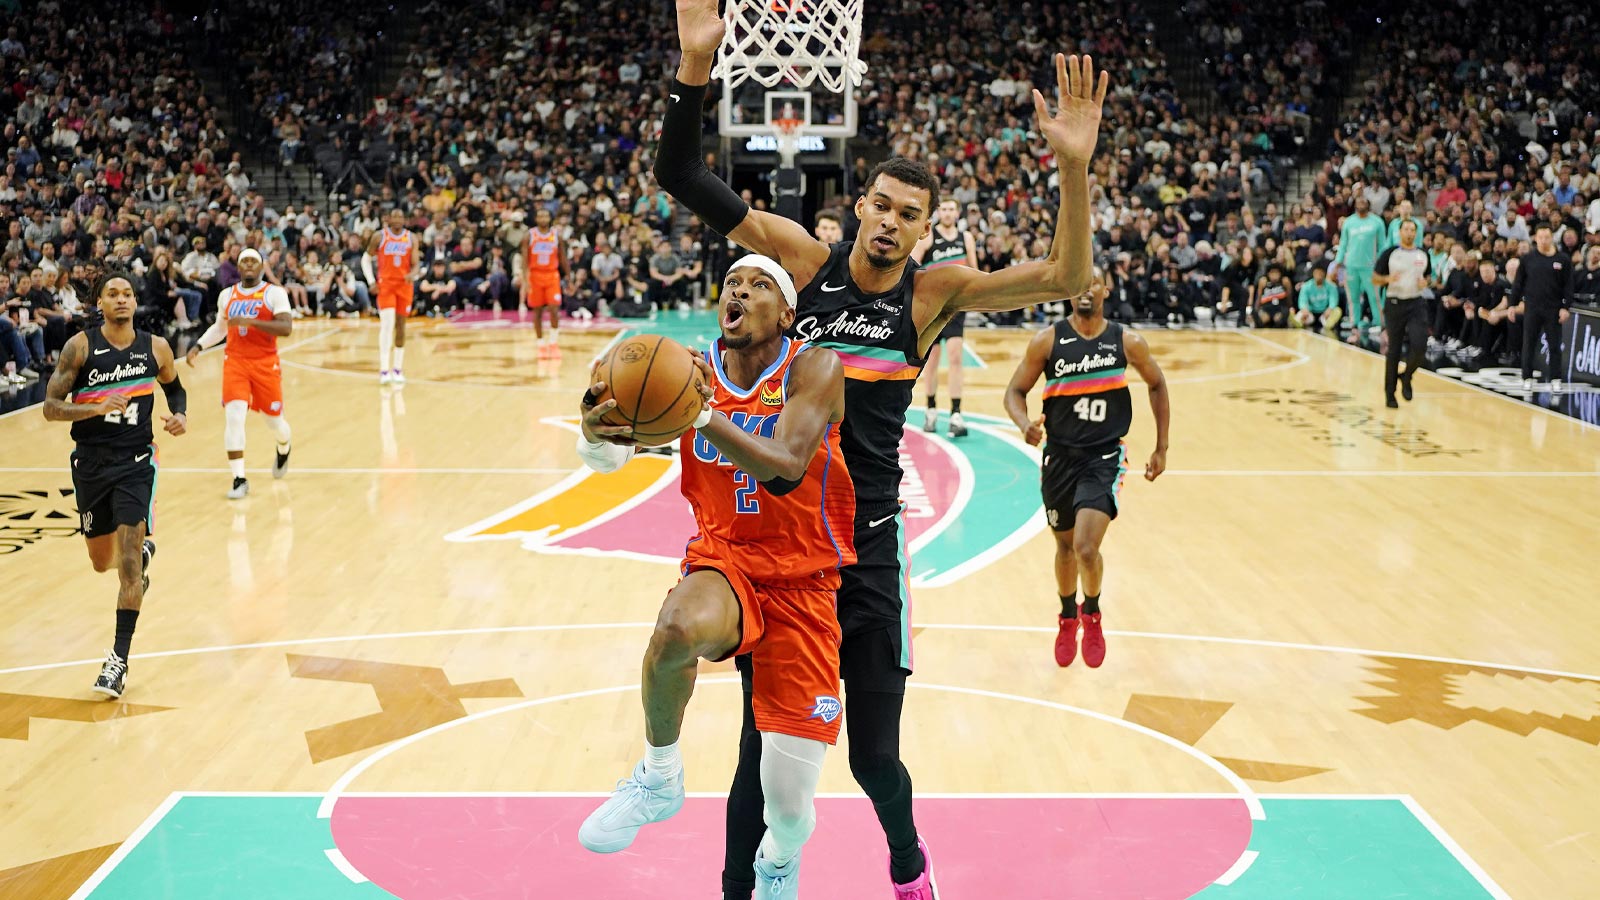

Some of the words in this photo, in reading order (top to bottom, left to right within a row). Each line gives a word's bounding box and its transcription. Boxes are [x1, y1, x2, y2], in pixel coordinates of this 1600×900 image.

[228, 300, 263, 318] OKC
[824, 310, 894, 340] Antonio
[88, 368, 110, 387] San
[109, 362, 148, 382] Antonio
[1054, 358, 1077, 378] San
[1076, 353, 1118, 373] Antonio
[1073, 397, 1107, 422] 40
[733, 469, 760, 514] 2
